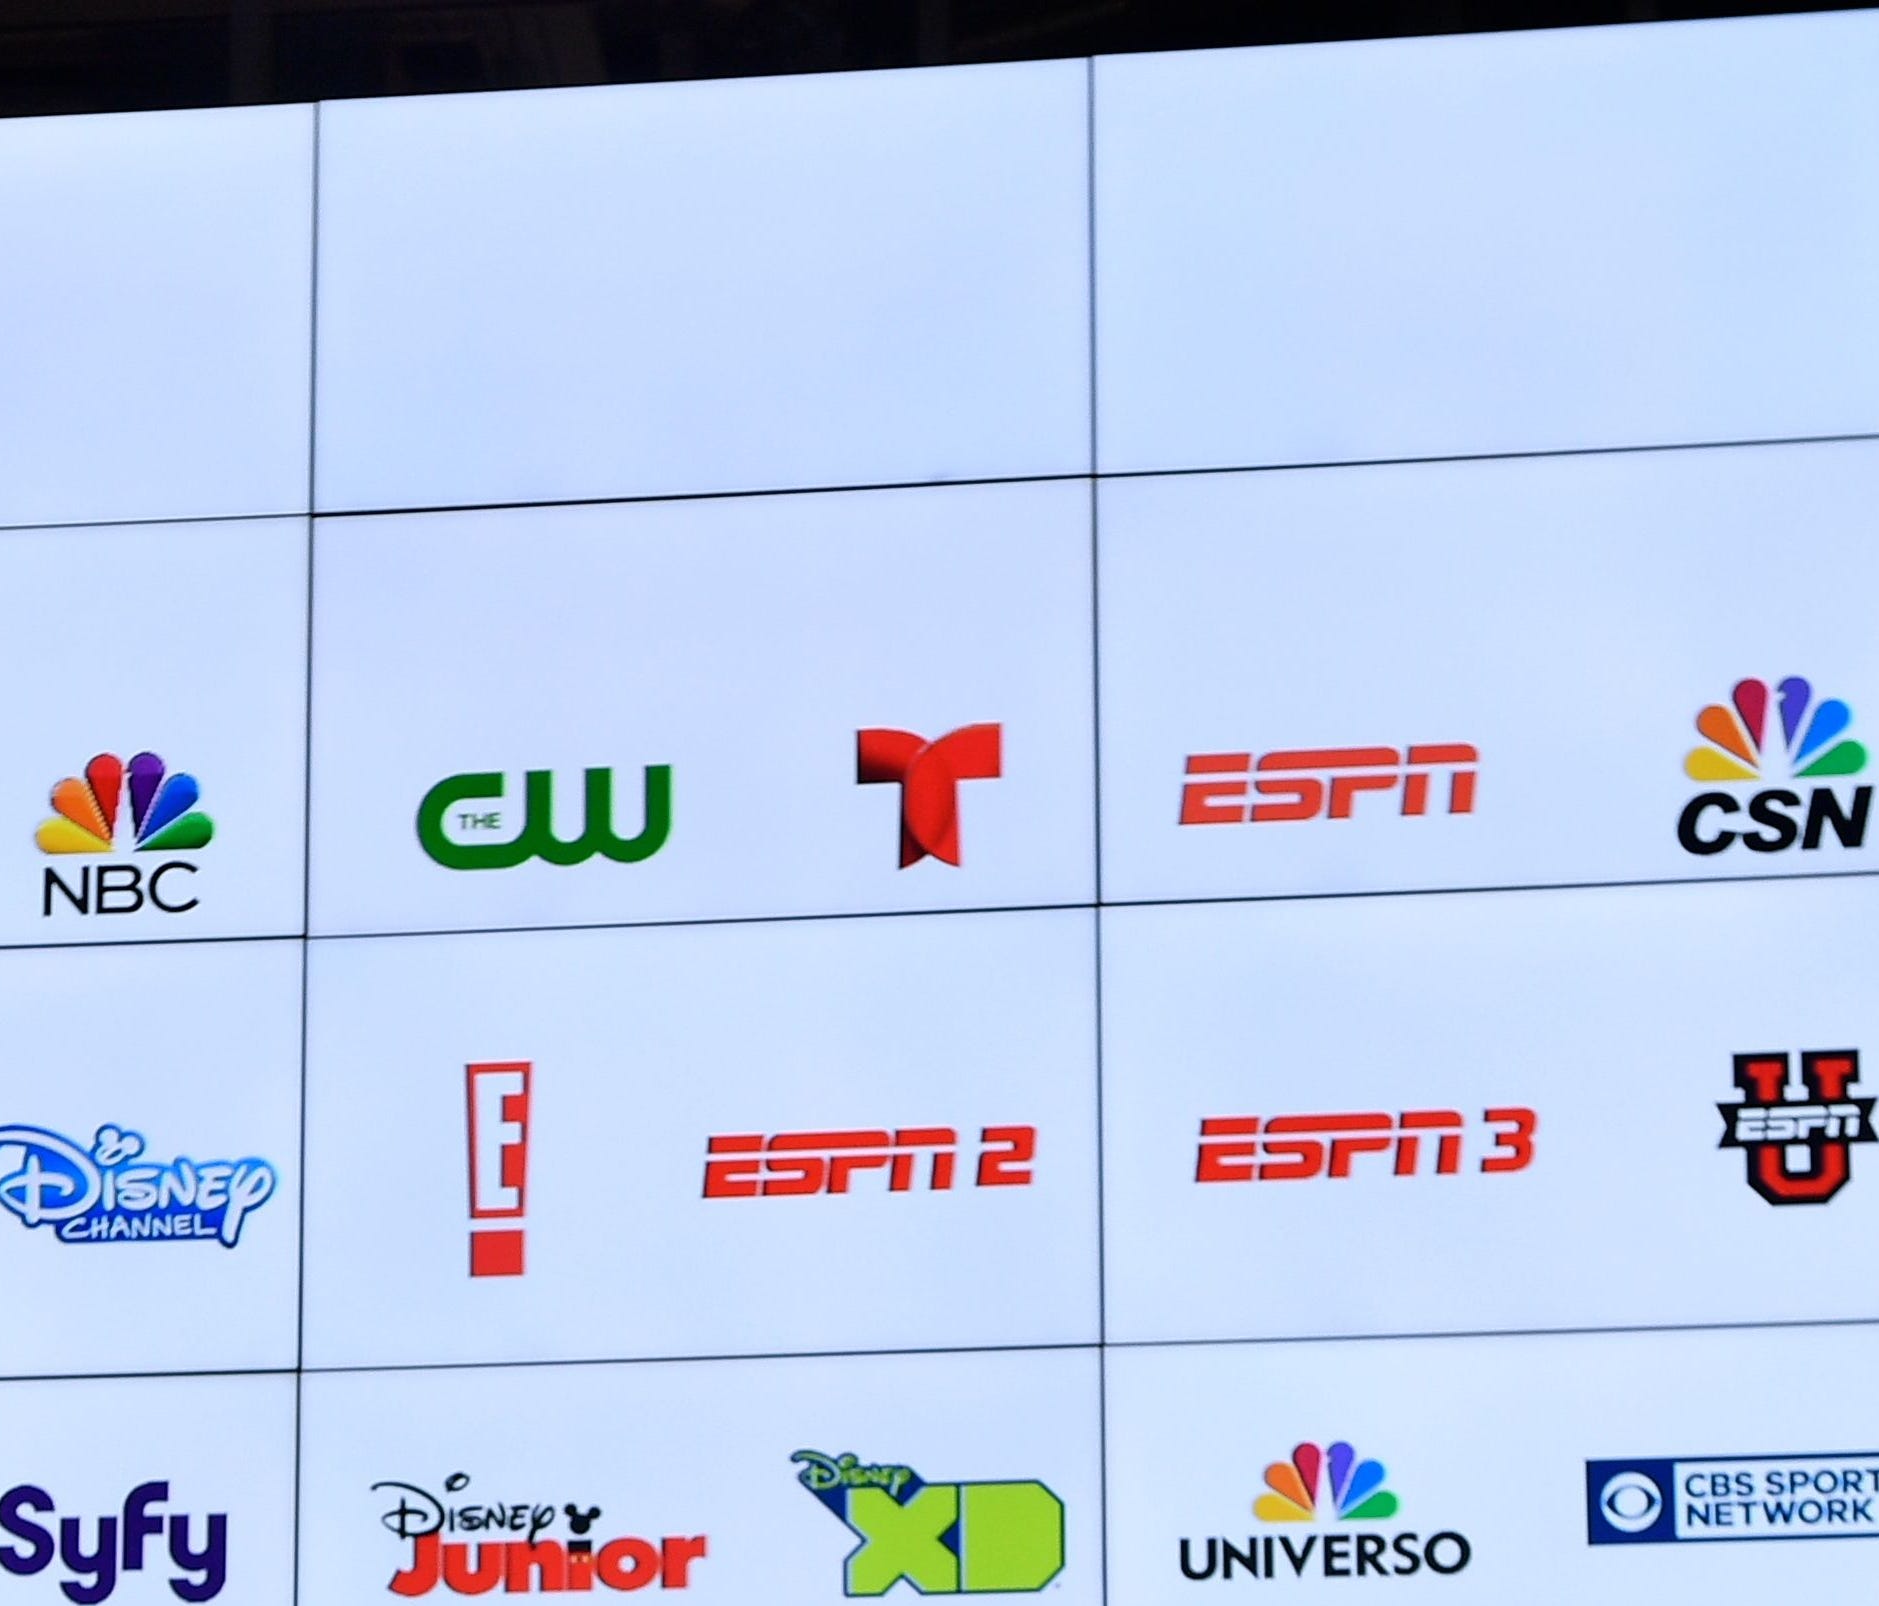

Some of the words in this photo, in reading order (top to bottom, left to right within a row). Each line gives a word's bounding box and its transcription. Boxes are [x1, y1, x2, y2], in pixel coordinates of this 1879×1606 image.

[1178, 743, 1479, 825] ESPN
[415, 763, 673, 871] CW
[457, 812, 501, 830] THE
[1677, 786, 1875, 856] CSN
[43, 861, 200, 917] NBC
[1194, 1110, 1464, 1183] ESPN
[1480, 1107, 1539, 1174] 3
[1735, 1104, 1861, 1142] ESPN
[702, 1128, 958, 1199] ESPN
[975, 1126, 1037, 1187] 2
[59, 1212, 219, 1239] CHANNEL
[790, 1449, 913, 1499] Disney
[1685, 1472, 1755, 1498] CBS
[370, 1471, 556, 1549] Disney
[843, 1480, 1066, 1597] XD
[1686, 1498, 1874, 1527] NETWORK
[387, 1526, 708, 1598] Junior
[1179, 1530, 1472, 1582] UNIVERSO
